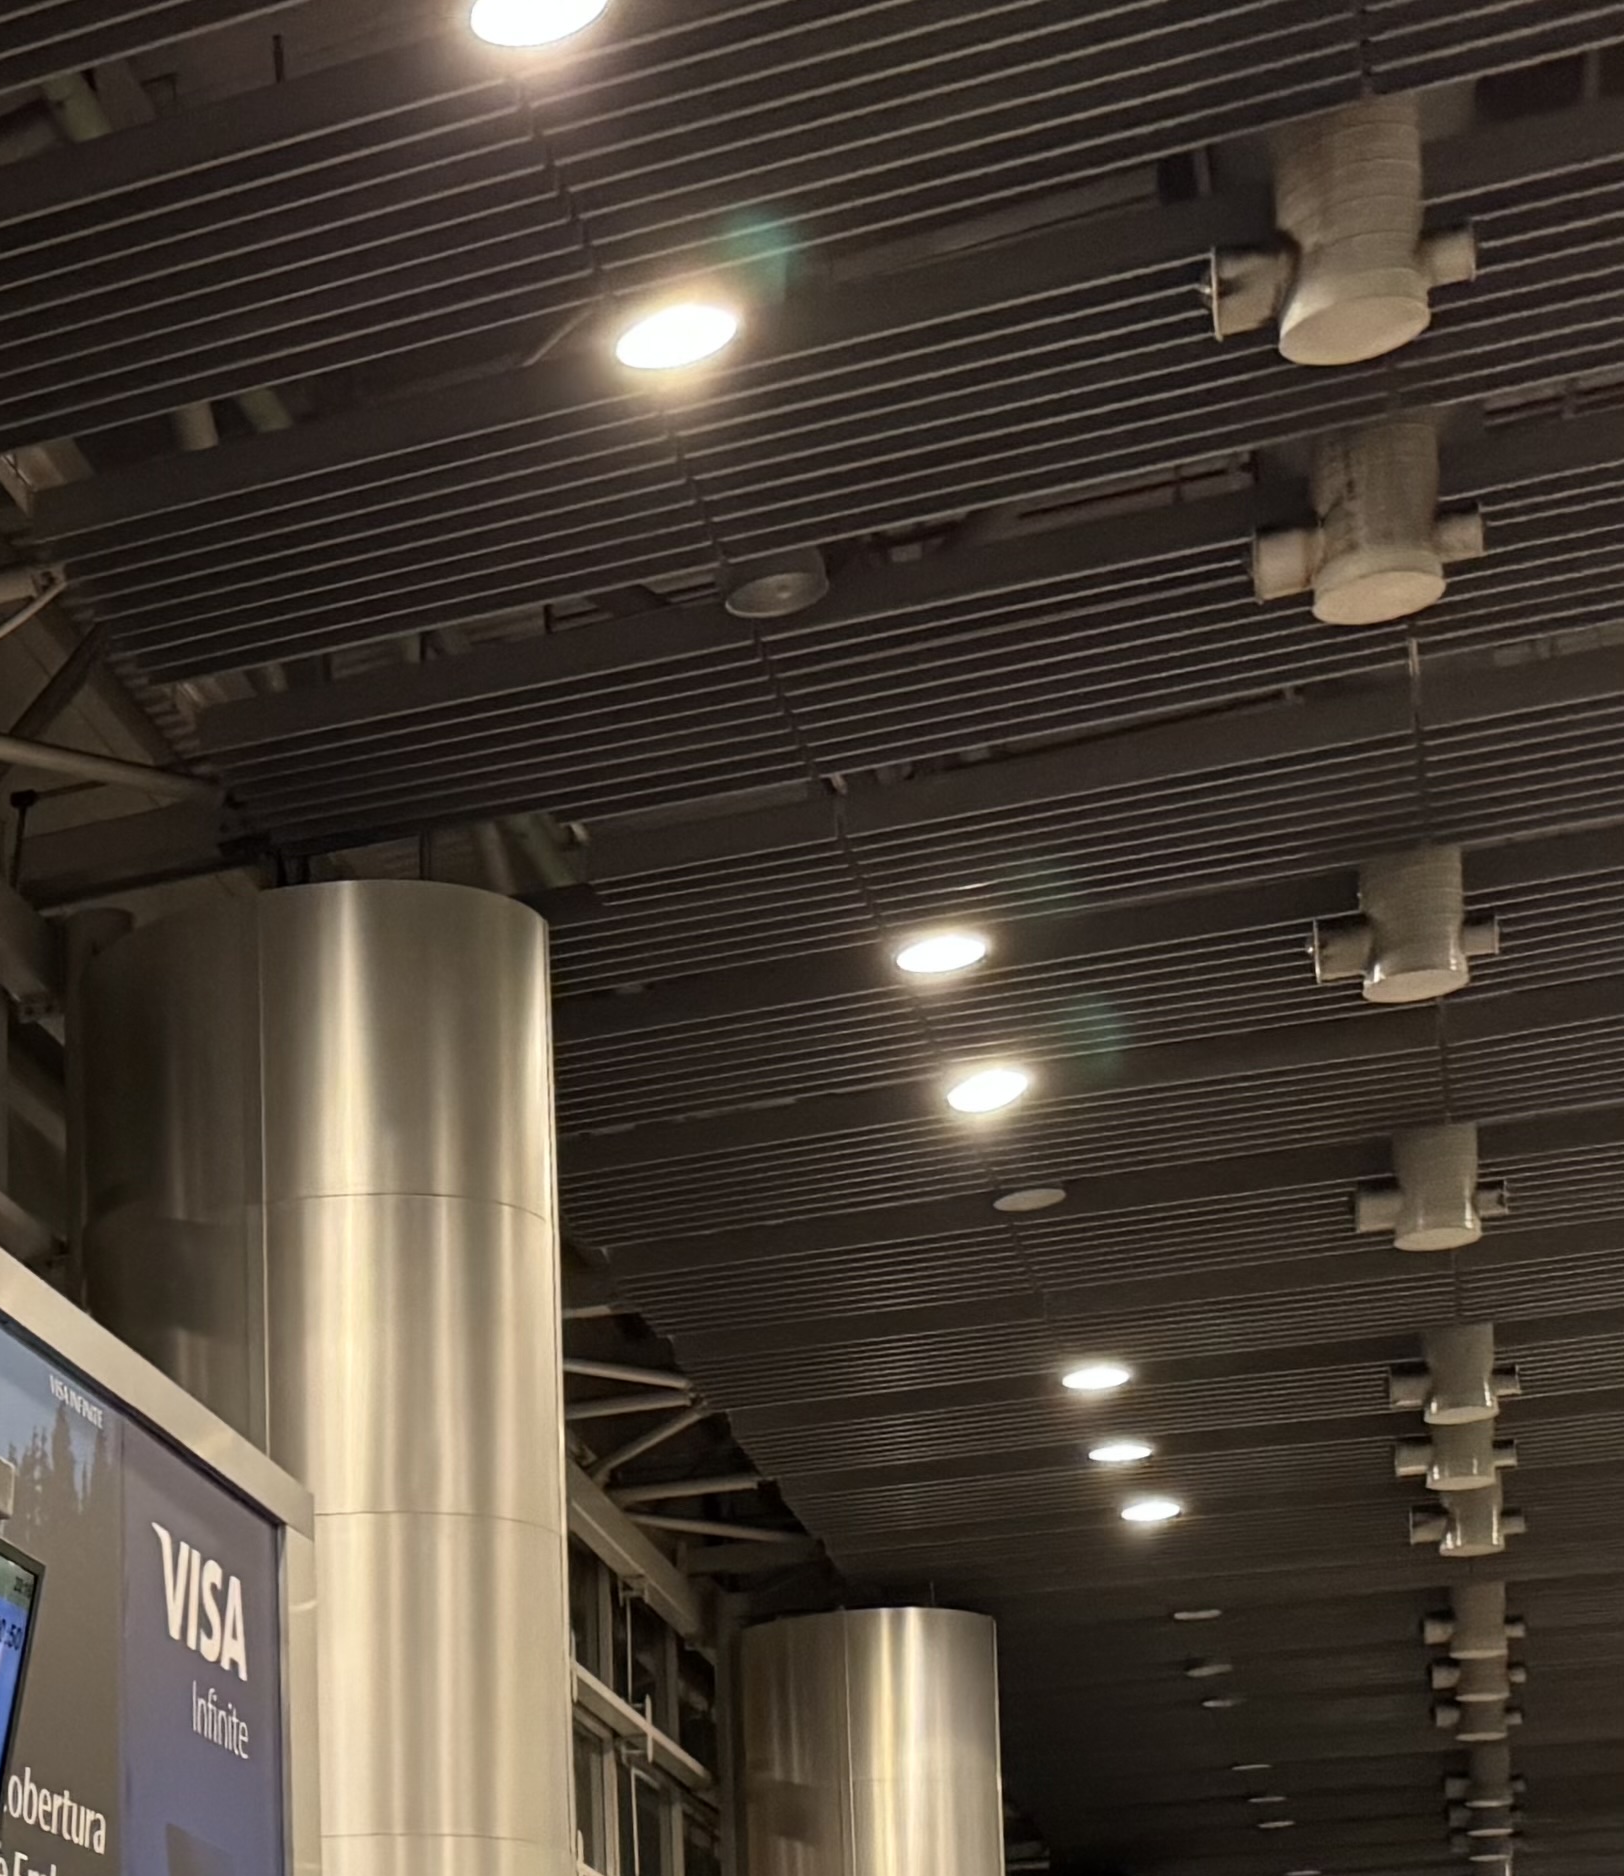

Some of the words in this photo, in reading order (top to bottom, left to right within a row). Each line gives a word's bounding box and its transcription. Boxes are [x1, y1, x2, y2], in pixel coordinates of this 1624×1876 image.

[151, 1521, 248, 1682] VISA
[192, 1680, 249, 1760] Infinite
[4, 1766, 106, 1854] obertura
